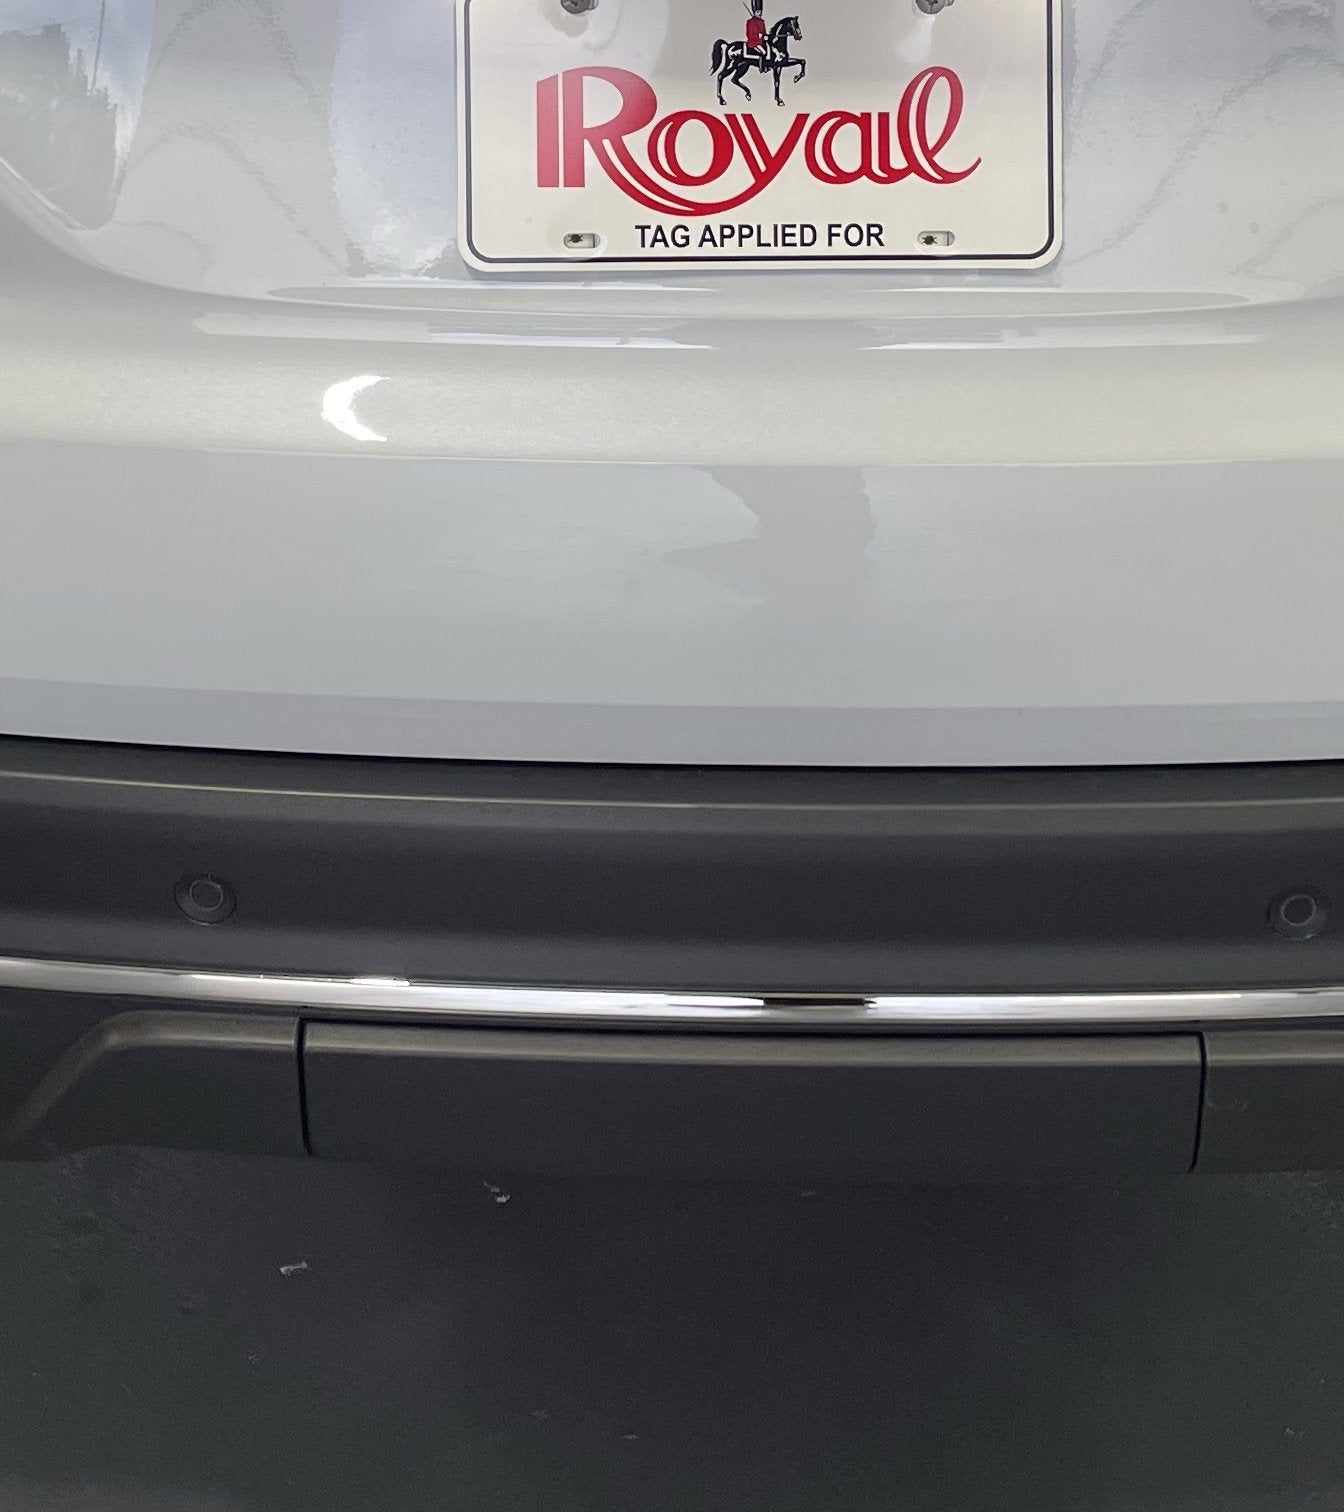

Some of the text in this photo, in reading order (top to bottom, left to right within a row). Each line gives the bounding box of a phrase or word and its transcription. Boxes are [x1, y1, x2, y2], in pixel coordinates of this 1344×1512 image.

[536, 65, 982, 217] Royal
[634, 223, 885, 249] TAG APPLIED FOR
